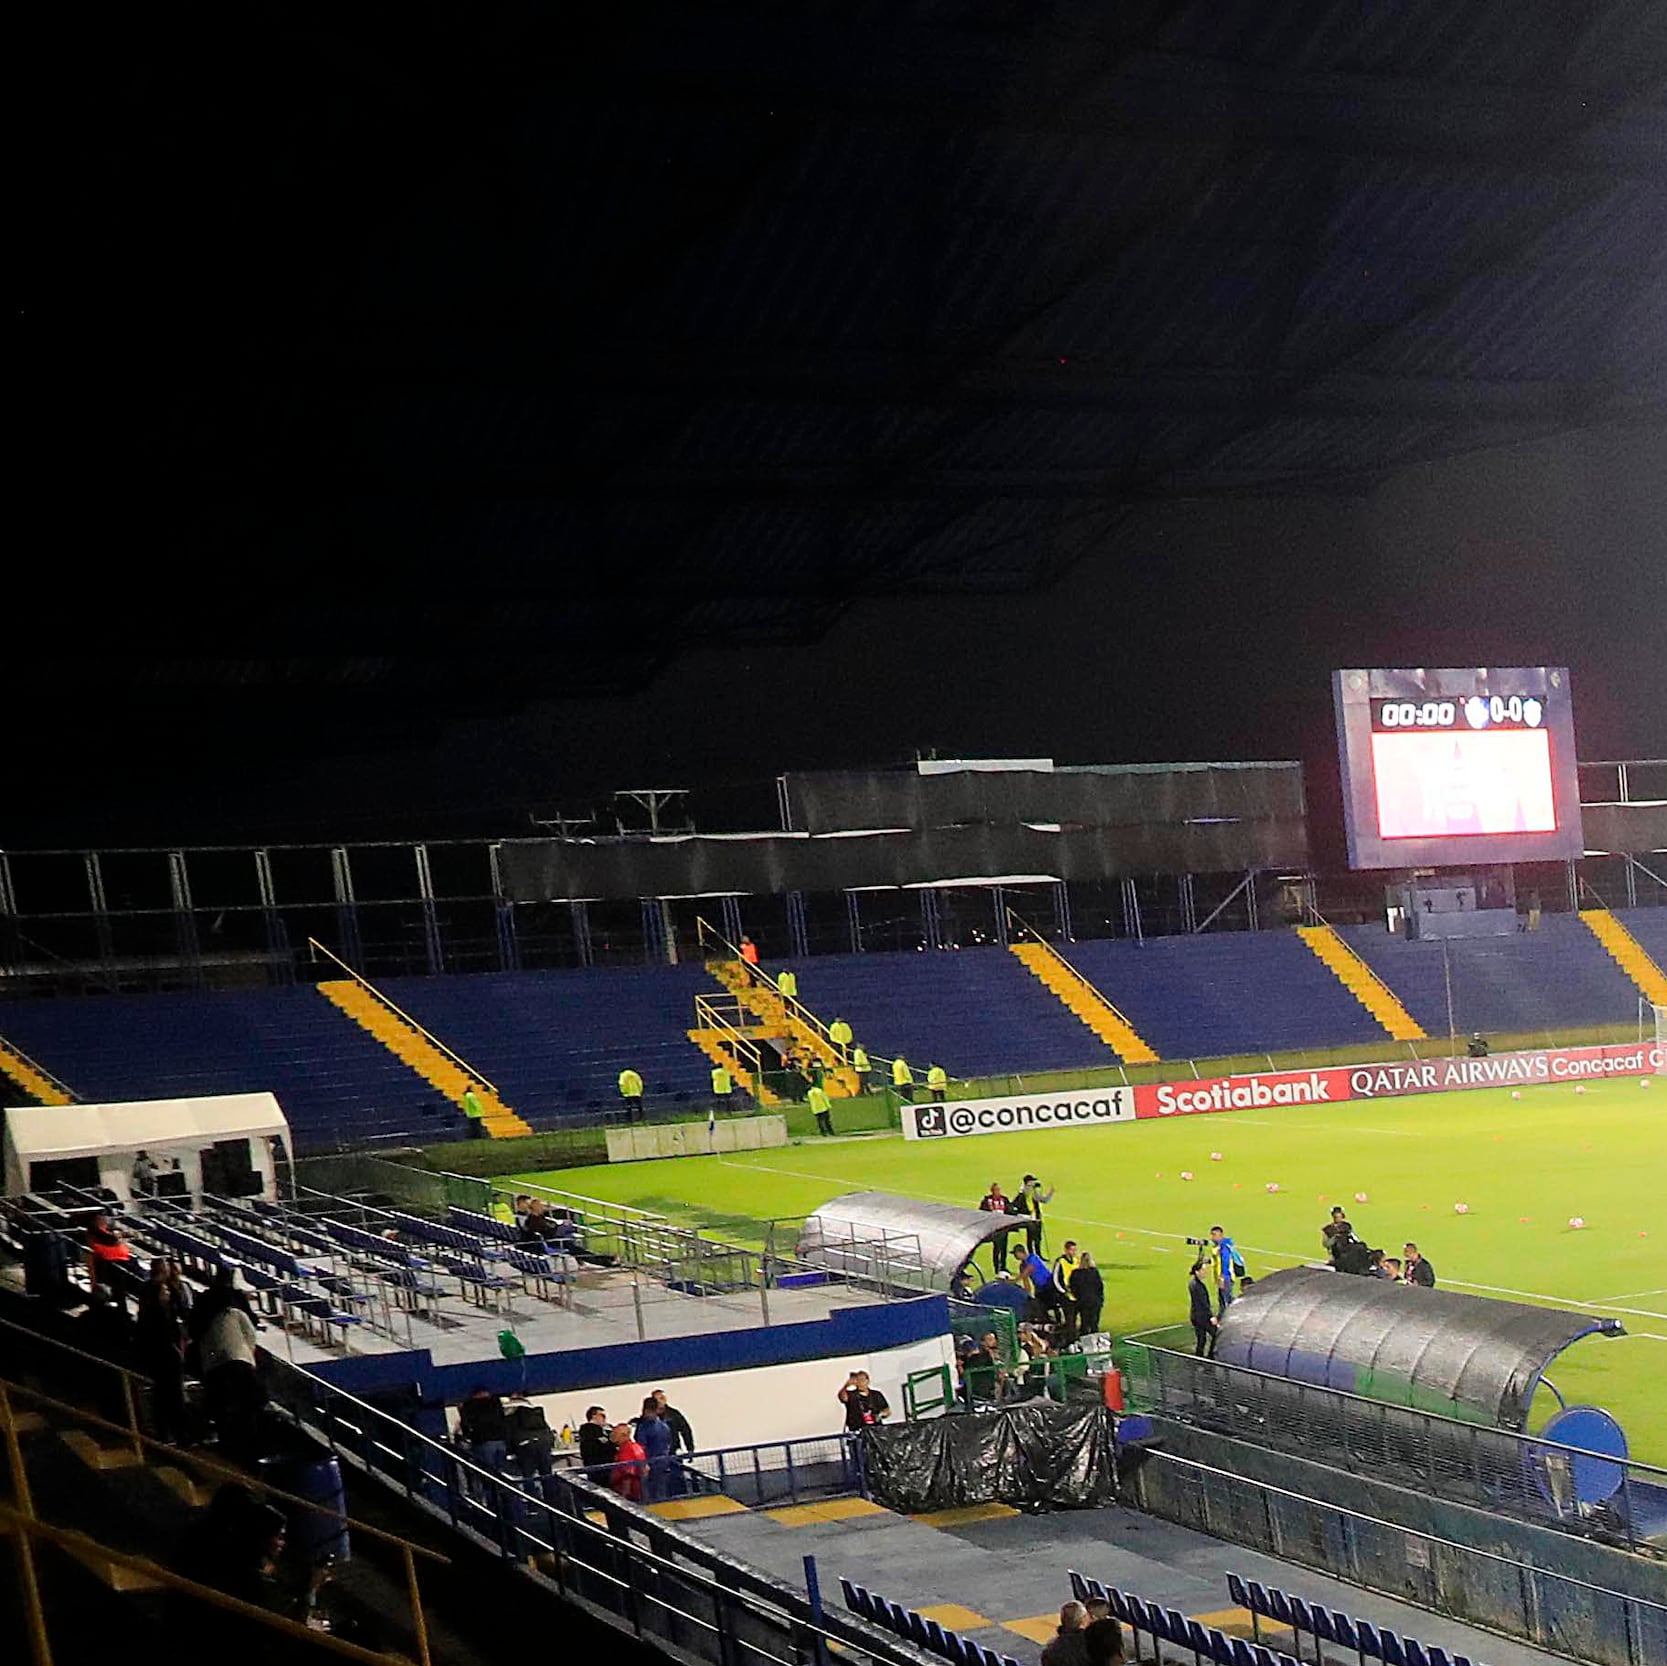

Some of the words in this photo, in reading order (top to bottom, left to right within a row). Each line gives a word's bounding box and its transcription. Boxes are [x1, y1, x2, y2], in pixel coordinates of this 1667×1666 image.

[1382, 703, 1455, 726] 00:00
[1490, 696, 1522, 723] 0-0
[1350, 1067, 1438, 1096] QATAR
[1444, 1056, 1549, 1085] AIRWAYS
[1551, 1050, 1644, 1076] Concacaf
[950, 1091, 1123, 1134] @concacaf
[1157, 1073, 1330, 1115] Scotiabank
